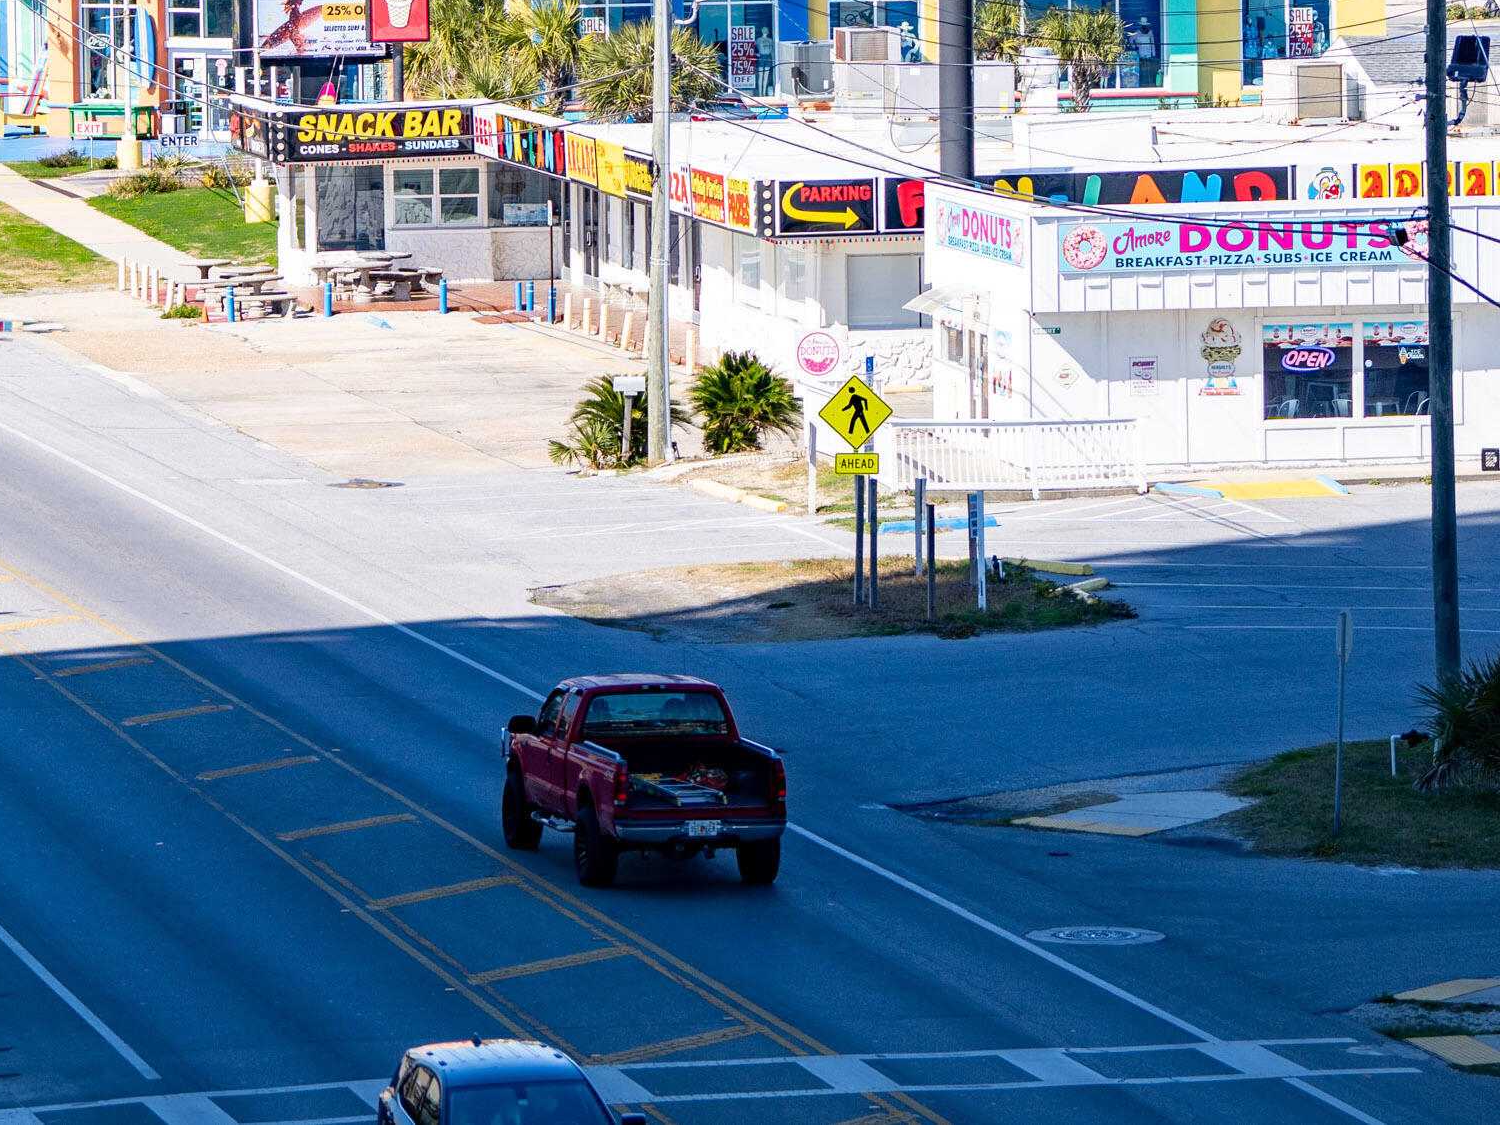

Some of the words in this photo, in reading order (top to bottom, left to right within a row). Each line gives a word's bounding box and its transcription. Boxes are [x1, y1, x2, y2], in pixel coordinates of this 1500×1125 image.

[326, 5, 352, 16] 25%
[1289, 8, 1312, 22] SALE
[579, 19, 603, 32] SALE
[1289, 23, 1312, 38] 25%
[732, 27, 754, 40] SALE
[89, 36, 111, 47] OPEN
[732, 43, 755, 56] 25%
[1290, 42, 1312, 56] 75%
[732, 60, 754, 74] 75%
[77, 123, 101, 134] EXIT
[298, 112, 396, 143] SNACK
[403, 108, 462, 138] BAR
[474, 116, 494, 148] BEER
[161, 136, 197, 146] ENTER
[300, 144, 340, 155] CONES
[348, 142, 396, 153] SHAKES
[405, 139, 460, 150] SUNDAES
[567, 137, 596, 180] ARCADE
[800, 185, 872, 202] PARKING
[728, 192, 750, 227] PRIZES
[962, 208, 1012, 249] DONUTS
[1179, 221, 1392, 253] DONUTS
[1115, 255, 1202, 267] BREAKFAST
[1209, 254, 1255, 266] PIZZA
[1263, 253, 1302, 263] SUBS
[1310, 252, 1333, 262] ICE
[1340, 251, 1392, 261] CREAM
[800, 346, 836, 355] DONUTS
[1285, 350, 1329, 368] OPEN
[841, 458, 874, 469] AHEAD
